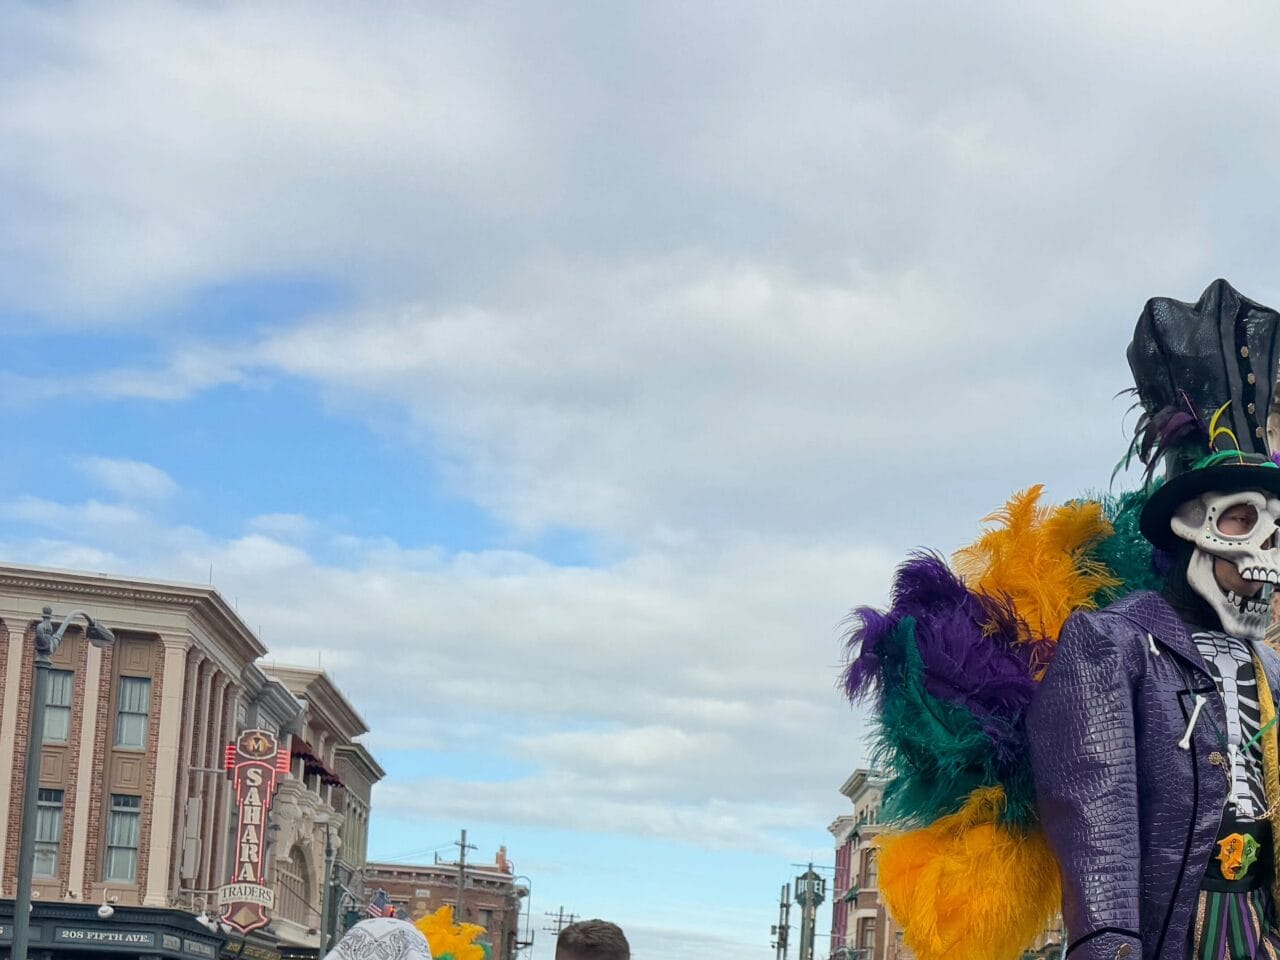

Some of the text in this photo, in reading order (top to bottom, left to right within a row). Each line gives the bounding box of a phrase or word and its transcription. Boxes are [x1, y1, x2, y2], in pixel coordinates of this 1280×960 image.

[238, 768, 262, 881] SAHARA
[221, 885, 272, 901] TRADERS
[61, 930, 84, 939] 208
[86, 931, 122, 941] FIFTH
